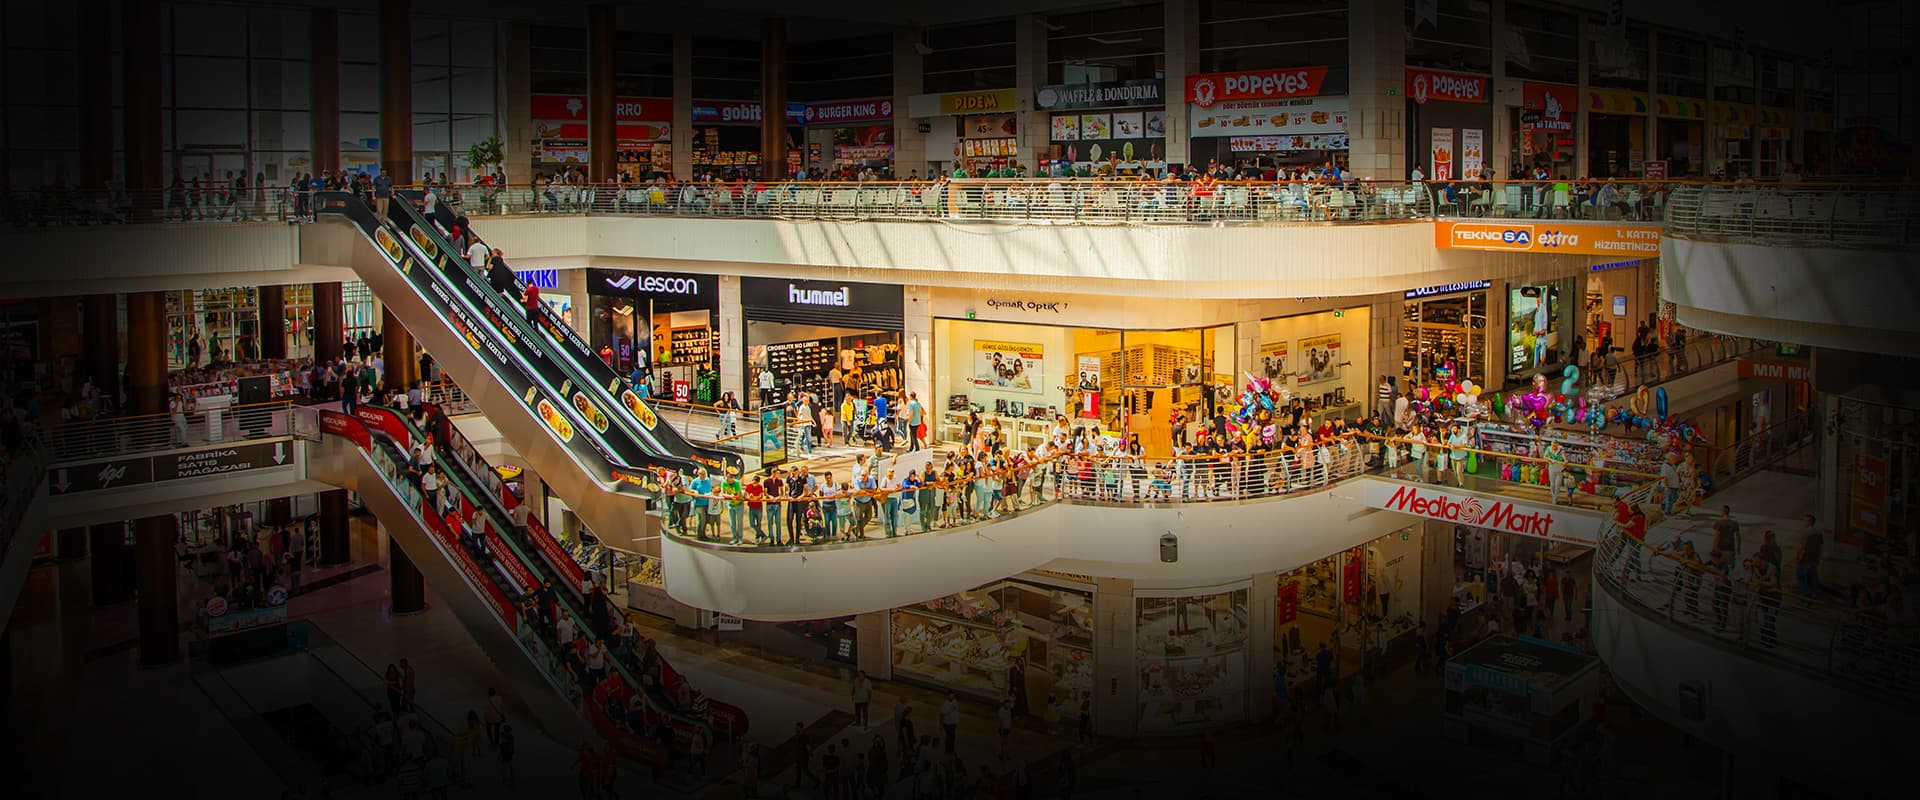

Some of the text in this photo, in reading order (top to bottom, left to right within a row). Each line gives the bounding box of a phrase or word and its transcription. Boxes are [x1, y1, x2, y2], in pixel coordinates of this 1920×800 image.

[1060, 84, 1158, 102] WAFFLE & DONDURMA
[617, 103, 642, 116] RRO
[819, 103, 876, 120] BURGER KING
[1537, 230, 1578, 247] extra
[1626, 229, 1658, 240] KATTA
[1594, 239, 1658, 252] HİZMETİNİZD
[789, 284, 849, 307] hummel
[1753, 363, 1783, 378] MM
[676, 384, 688, 398] 50
[1385, 486, 1553, 538] Media Markt
